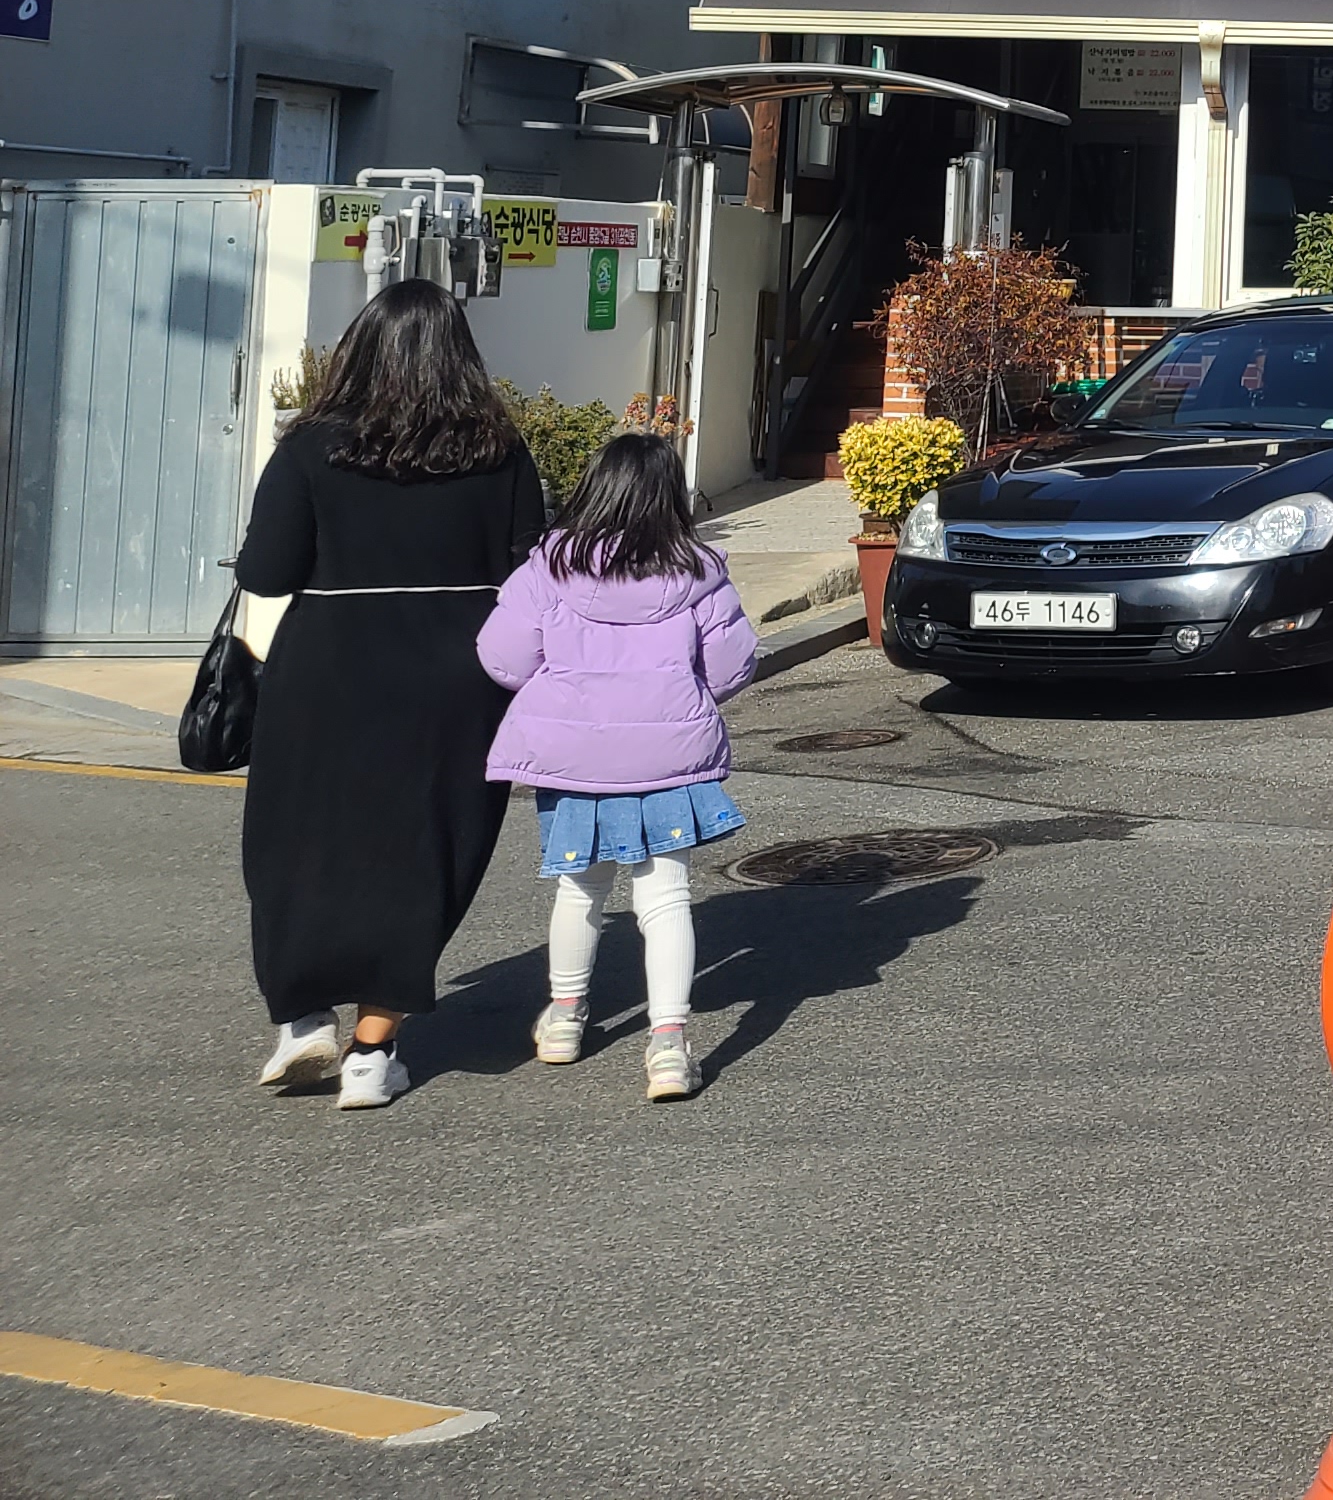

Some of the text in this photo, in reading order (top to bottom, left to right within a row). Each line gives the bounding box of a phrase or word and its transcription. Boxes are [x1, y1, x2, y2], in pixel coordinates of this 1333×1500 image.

[494, 206, 557, 246] 순광식당
[985, 599, 1100, 624] 46두 1146
